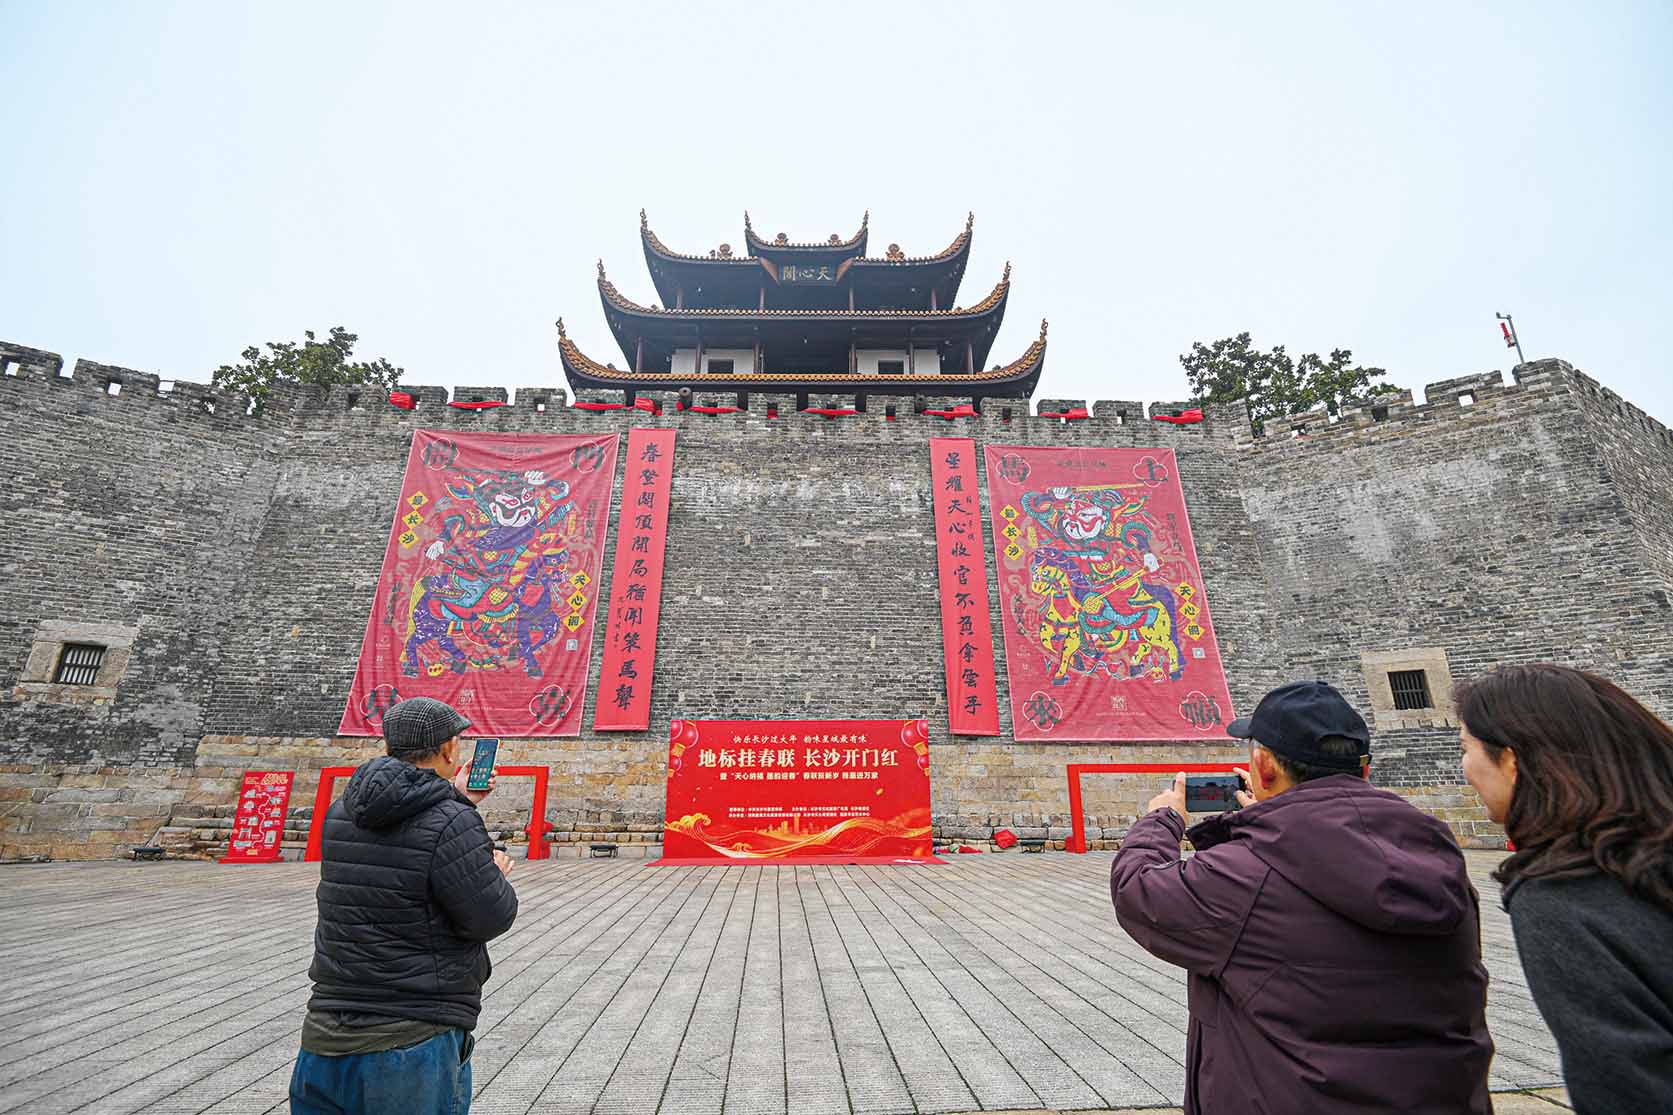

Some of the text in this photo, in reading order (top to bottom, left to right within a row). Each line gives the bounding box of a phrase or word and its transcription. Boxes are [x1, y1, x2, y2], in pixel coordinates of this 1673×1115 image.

[698, 748, 898, 768] 地标挂春联 长沙开门红
